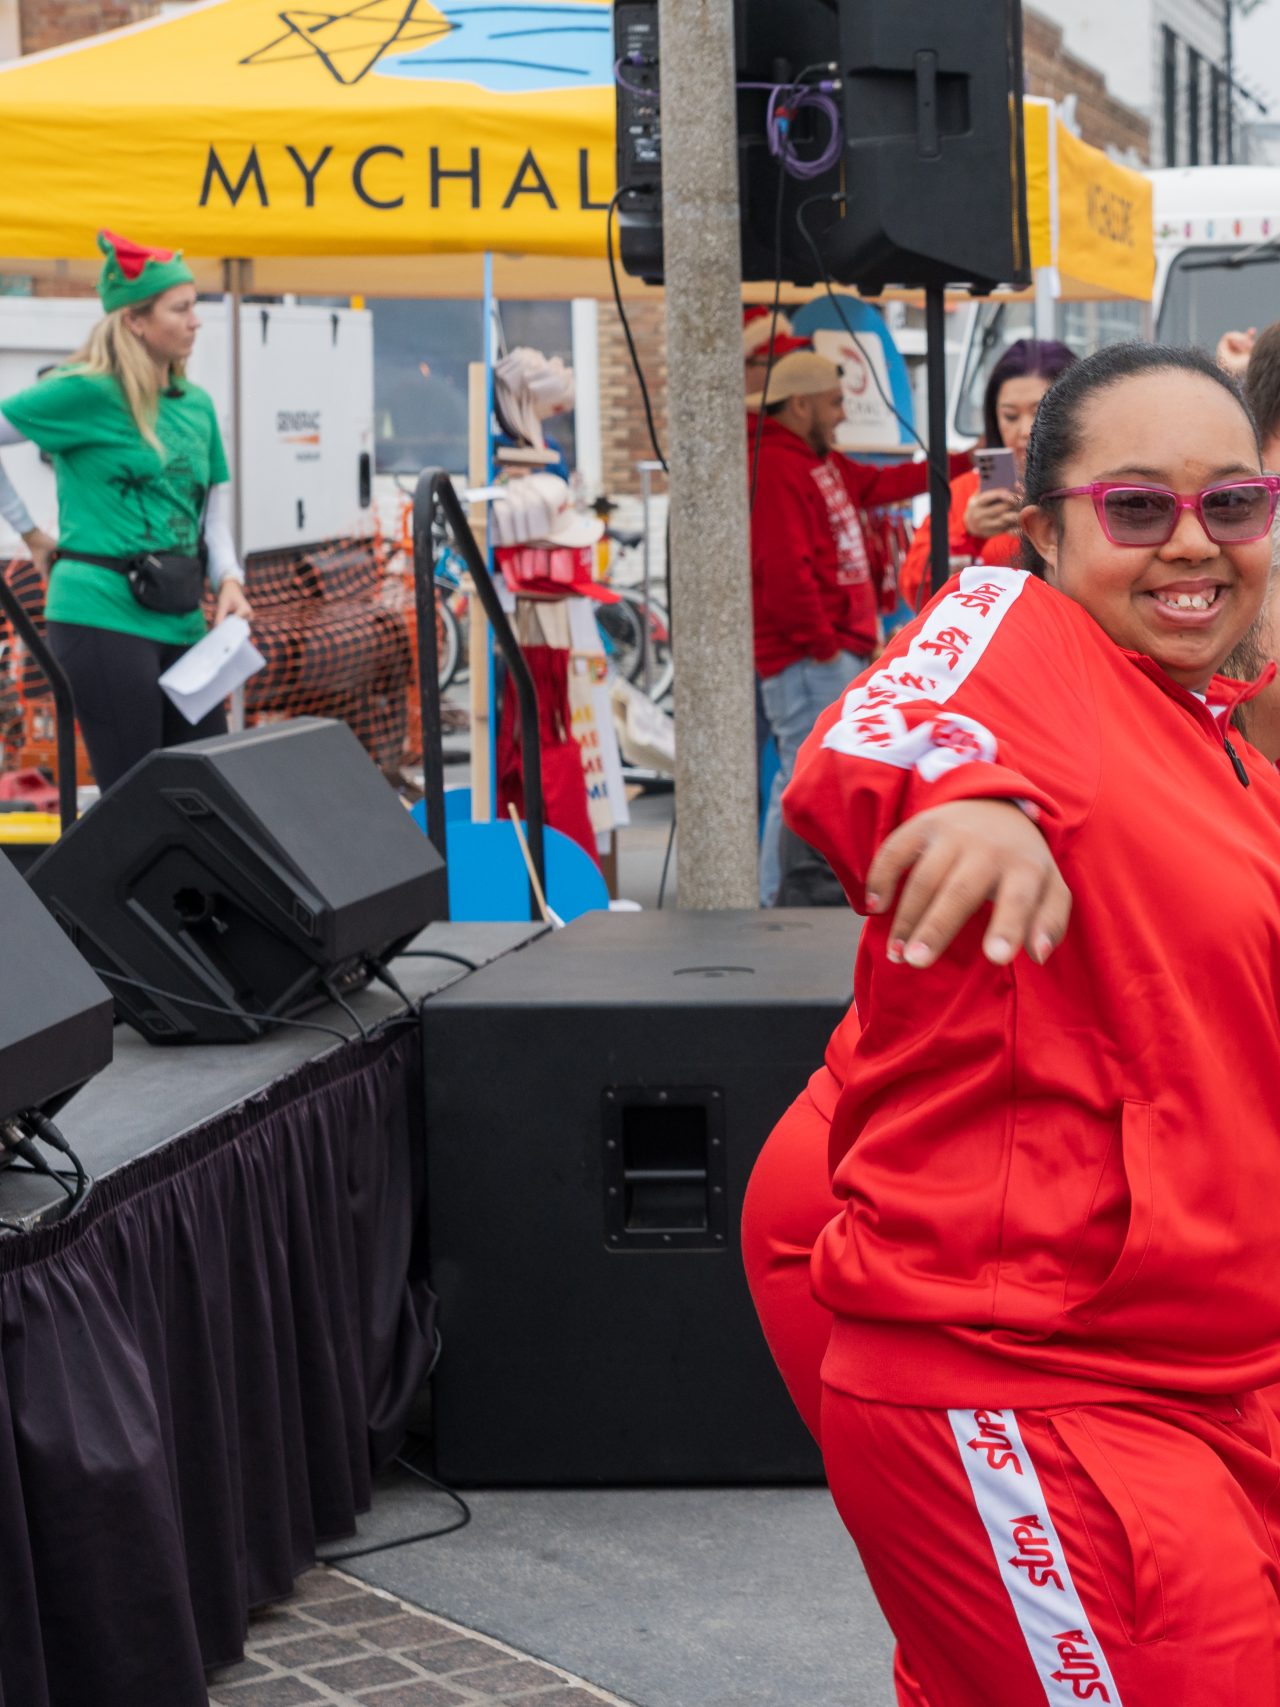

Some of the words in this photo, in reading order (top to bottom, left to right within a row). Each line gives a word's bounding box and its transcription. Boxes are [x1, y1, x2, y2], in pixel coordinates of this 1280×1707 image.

[198, 145, 611, 210] MYCHAL
[1007, 1514, 1065, 1592] SUPA
[1049, 1629, 1111, 1704] SUPA
